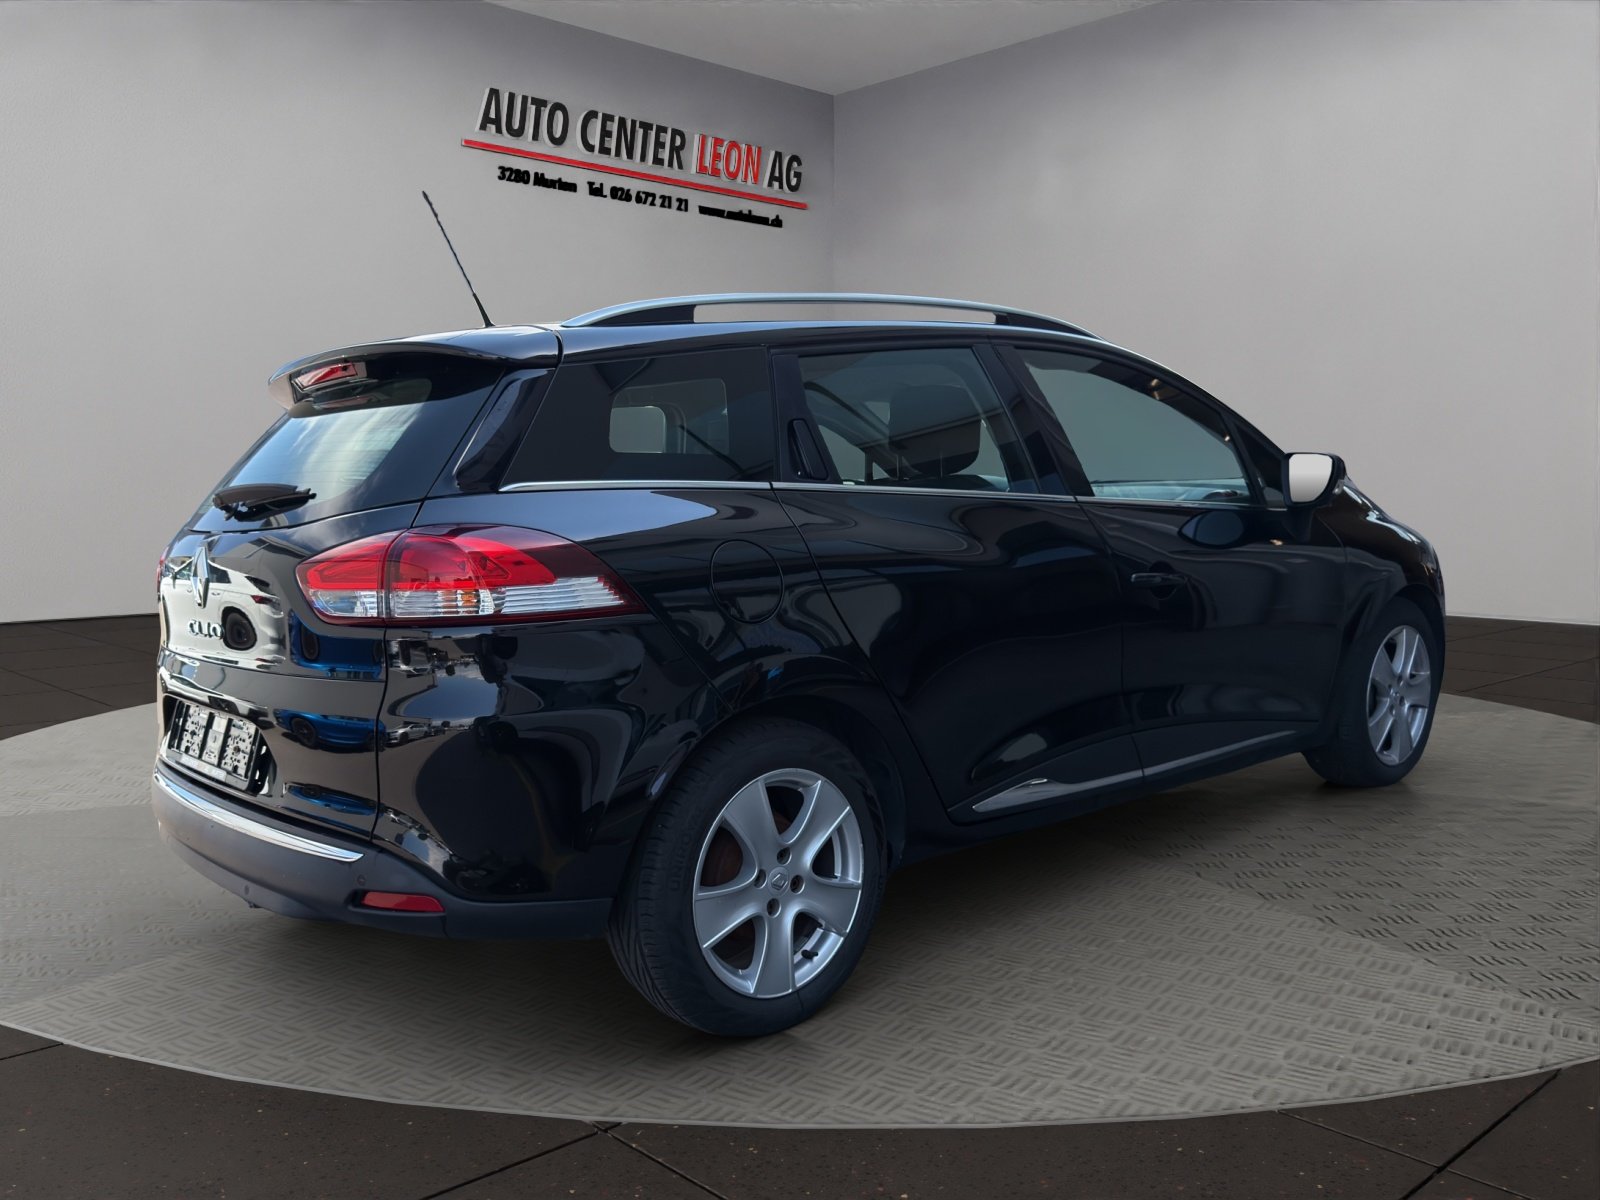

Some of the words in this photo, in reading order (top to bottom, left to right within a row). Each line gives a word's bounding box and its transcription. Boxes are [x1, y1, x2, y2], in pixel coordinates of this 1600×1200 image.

[477, 87, 570, 146] AUTO
[577, 109, 687, 171] CENTER
[695, 133, 762, 185] LEON
[766, 150, 803, 193] AG
[497, 165, 531, 185] 3280
[609, 185, 633, 203] 026
[634, 190, 657, 207] 672
[658, 194, 673, 210] 21
[675, 197, 689, 213] 21
[188, 619, 224, 640] CLIO
